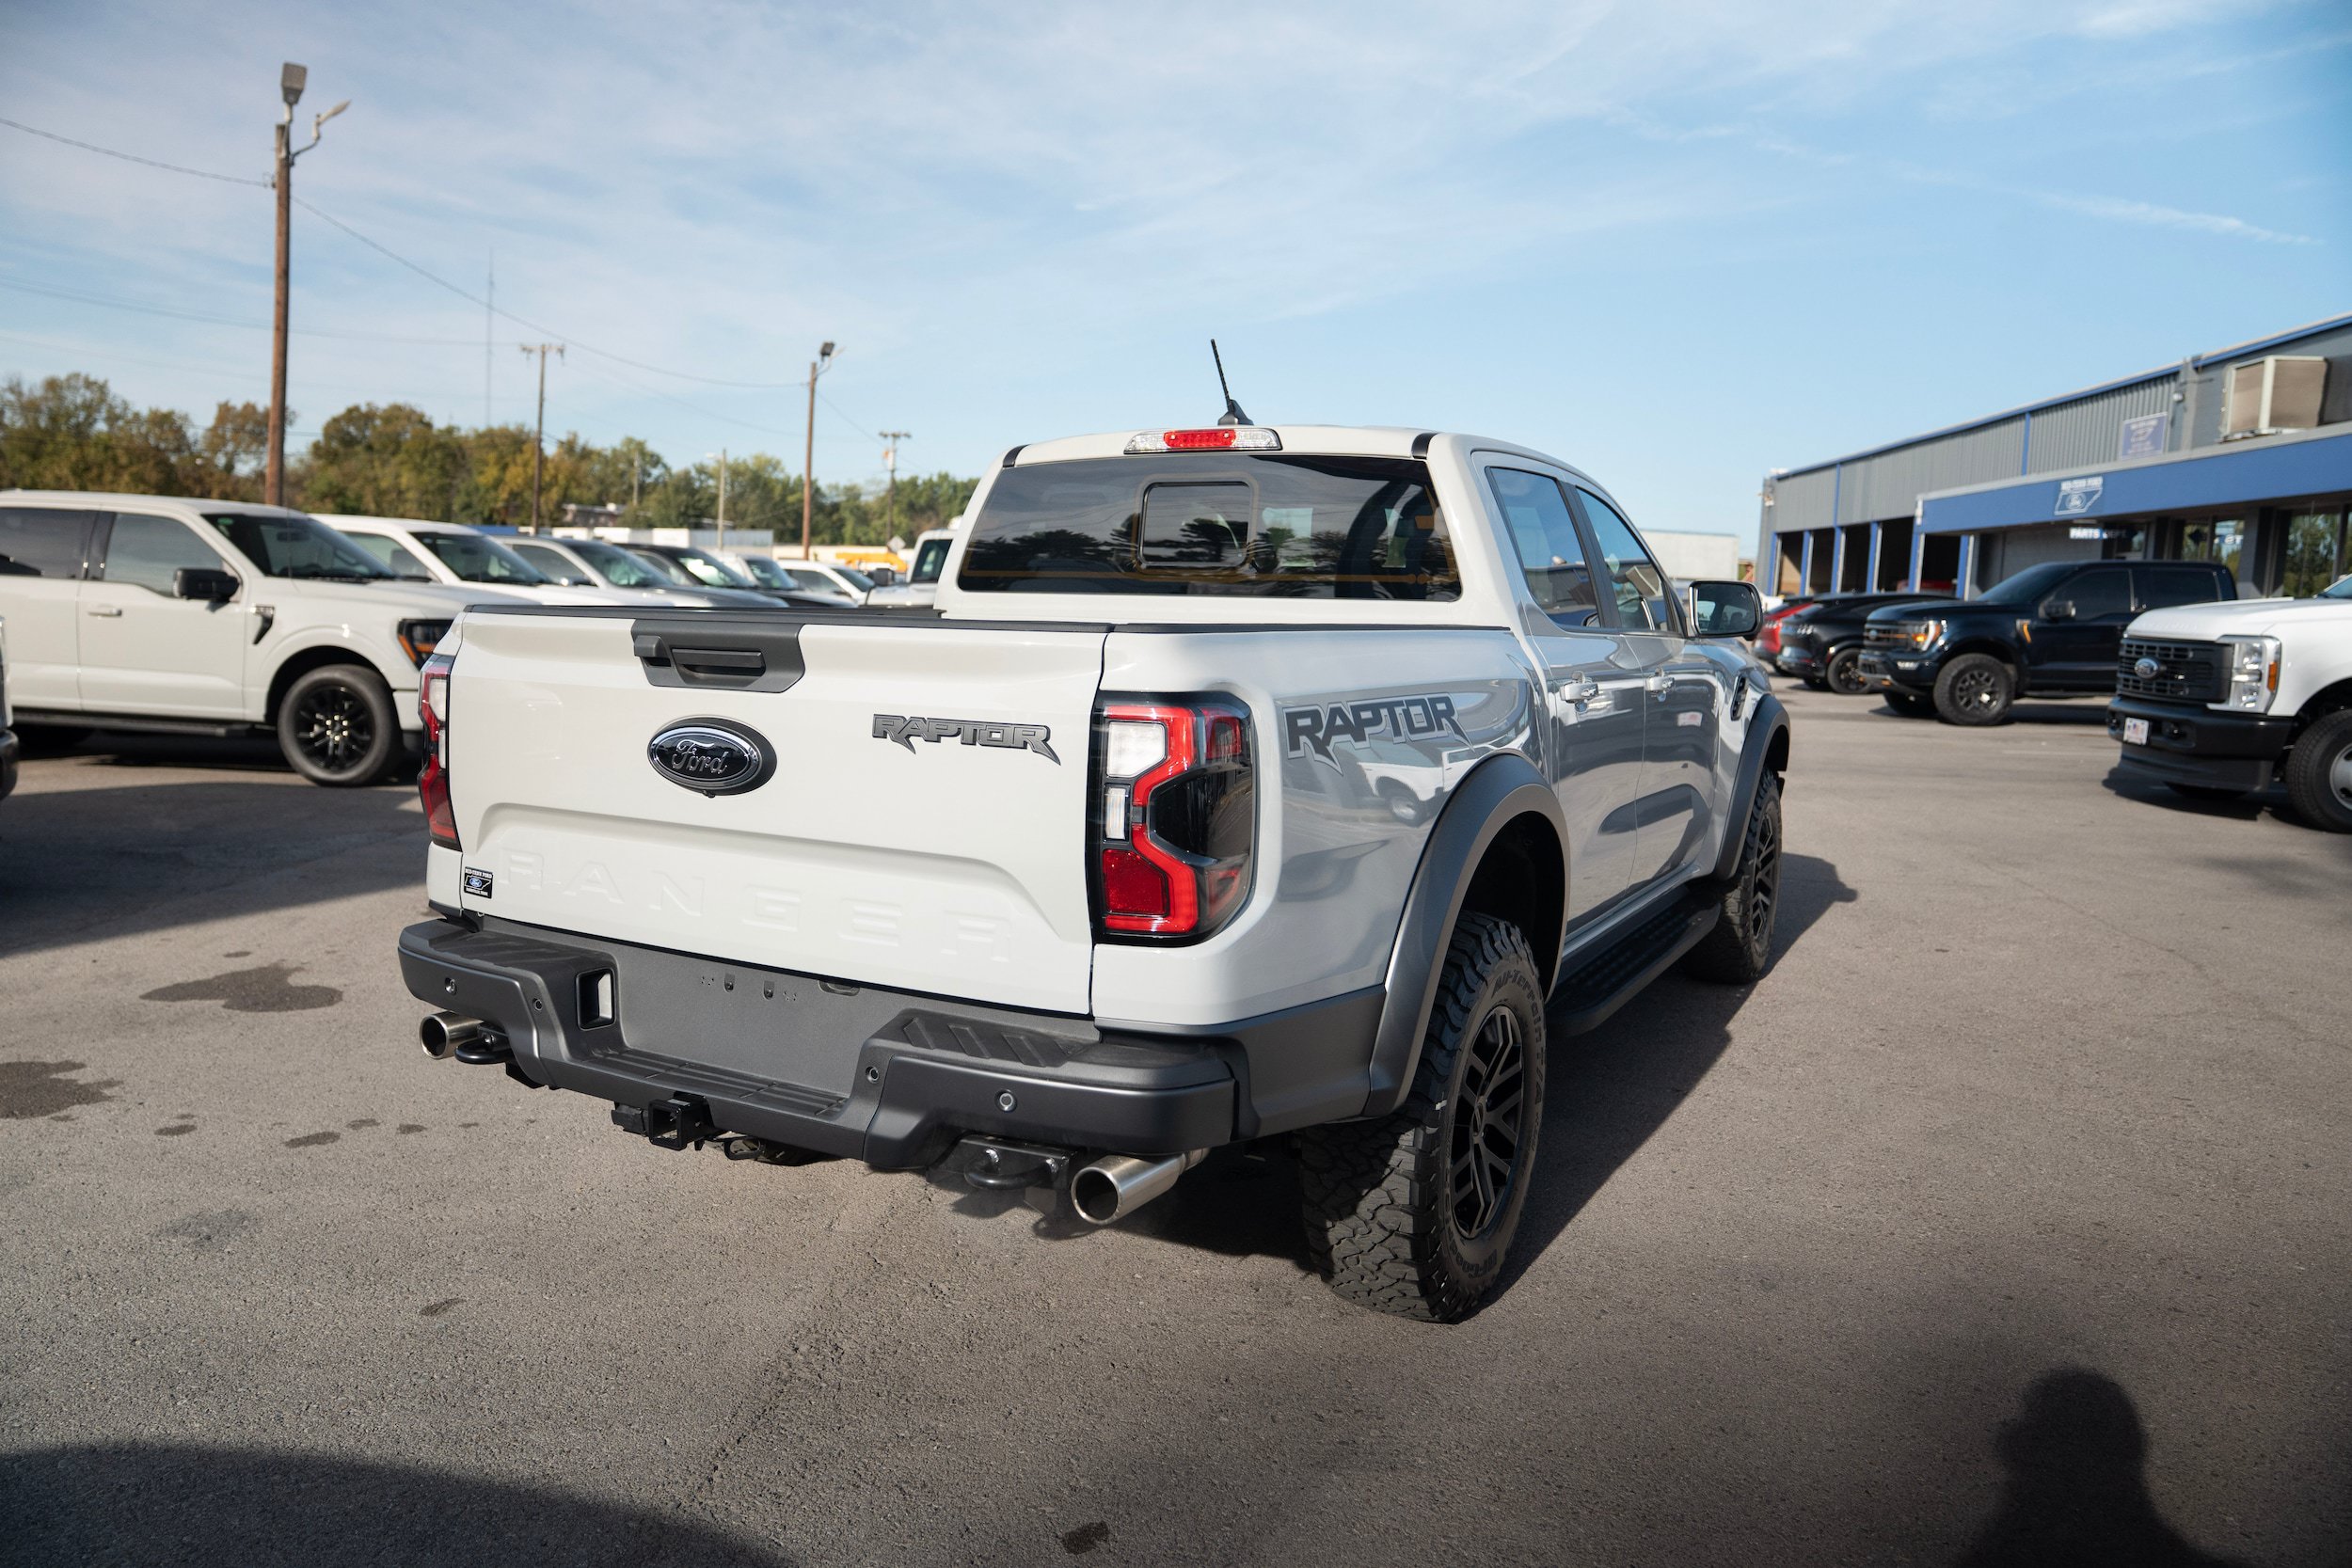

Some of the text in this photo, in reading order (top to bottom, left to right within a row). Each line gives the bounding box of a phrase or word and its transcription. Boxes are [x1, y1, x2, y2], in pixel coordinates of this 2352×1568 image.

[671, 738, 729, 775] Ford
[871, 713, 1061, 767] RAPTOR
[1283, 692, 1475, 776] RAPTOR
[497, 847, 1016, 963] RANGER
